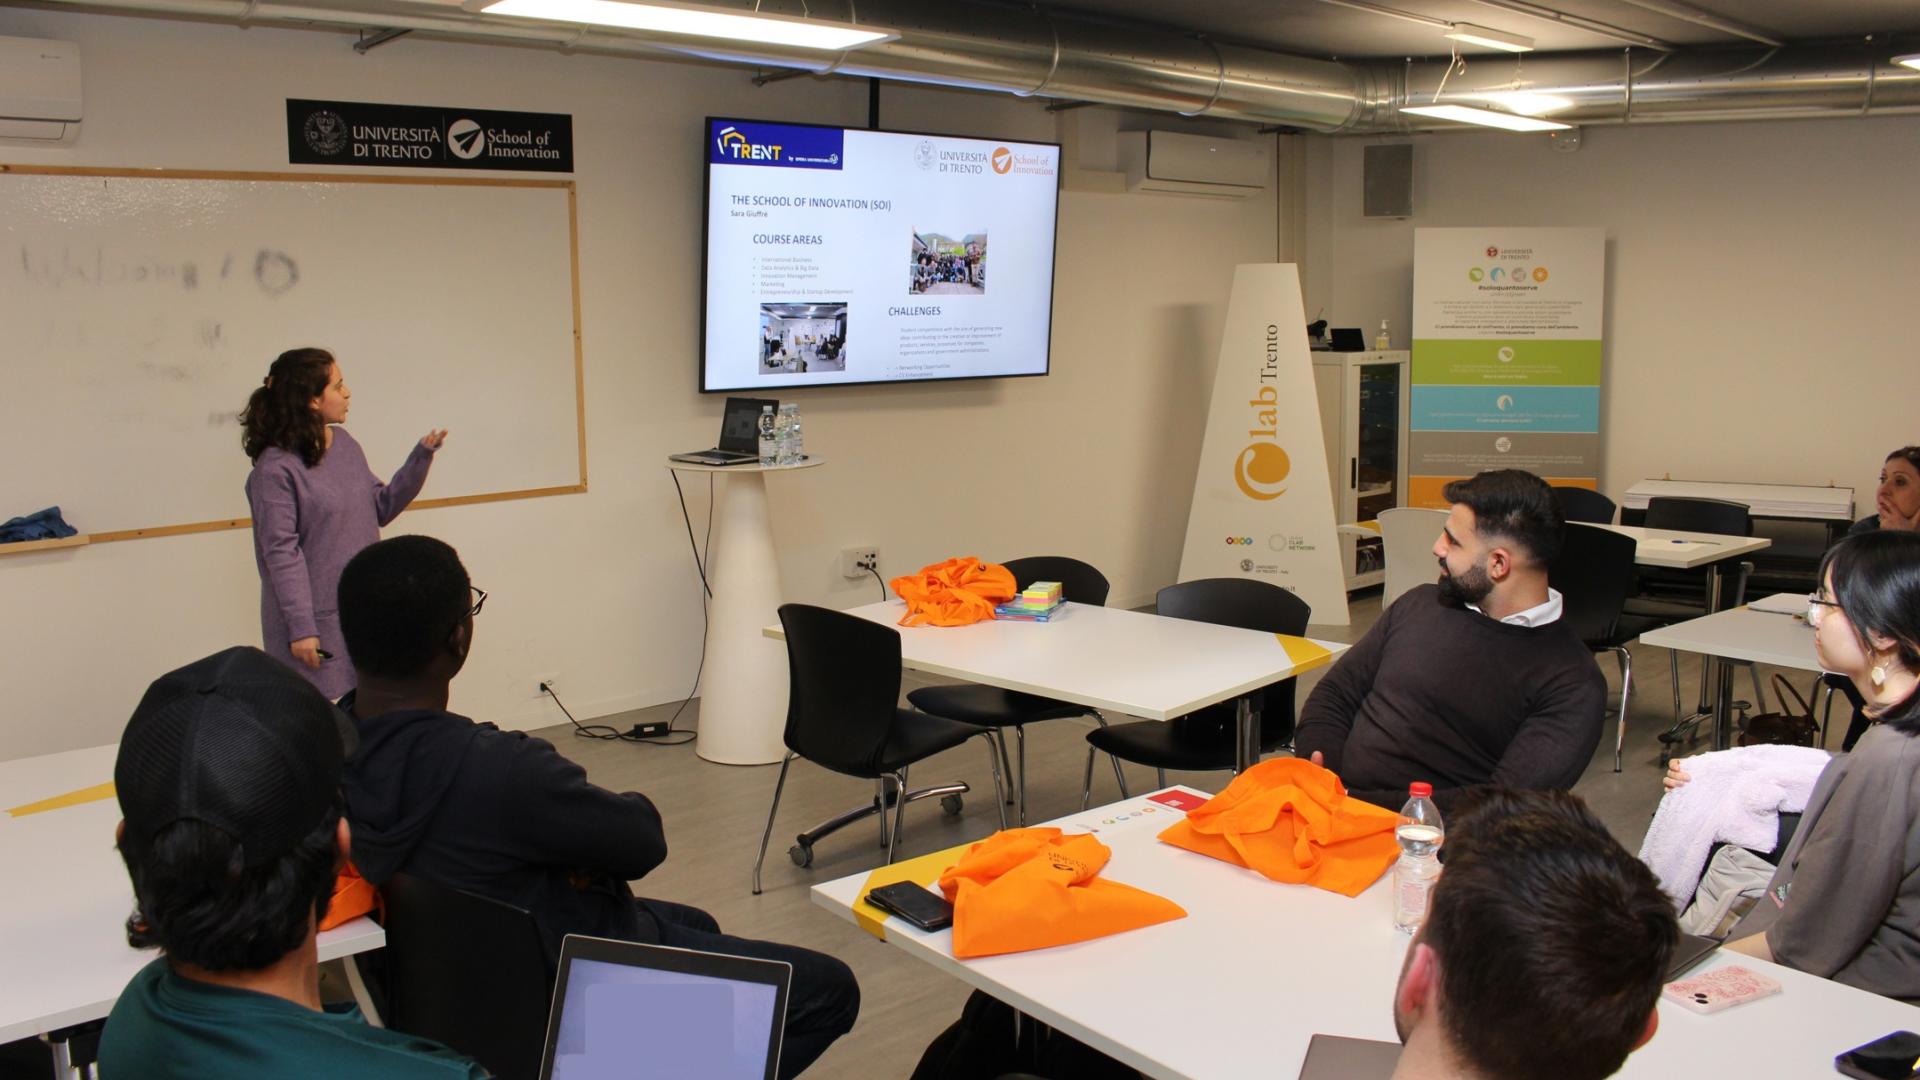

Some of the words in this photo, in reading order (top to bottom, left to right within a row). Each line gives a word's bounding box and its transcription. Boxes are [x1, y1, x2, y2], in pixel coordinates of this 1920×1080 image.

[352, 125, 441, 143] UNIVERSITÀ
[488, 128, 532, 145] School
[536, 130, 551, 146] of
[354, 144, 369, 157] DI
[373, 145, 432, 160] TRENTO
[488, 143, 560, 160] Innovation
[731, 143, 782, 161] TRENT
[939, 151, 988, 163] UNIVERSITÀ
[1014, 155, 1039, 165] School
[1041, 155, 1049, 166] of
[939, 163, 948, 172] DI
[950, 164, 983, 175] TRENTO
[1013, 165, 1054, 176] Innovation
[731, 194, 751, 205] THE
[752, 195, 792, 207] SCHOOL
[793, 197, 807, 207] OF
[809, 197, 868, 209] INNOVATION
[870, 200, 891, 212] (SOI)
[730, 209, 745, 217] Sara
[753, 233, 791, 245] COURSE
[792, 234, 823, 245] AREAS
[760, 281, 785, 289] Marketing
[888, 306, 941, 317] CHALLENGES
[1260, 324, 1279, 384] Trento
